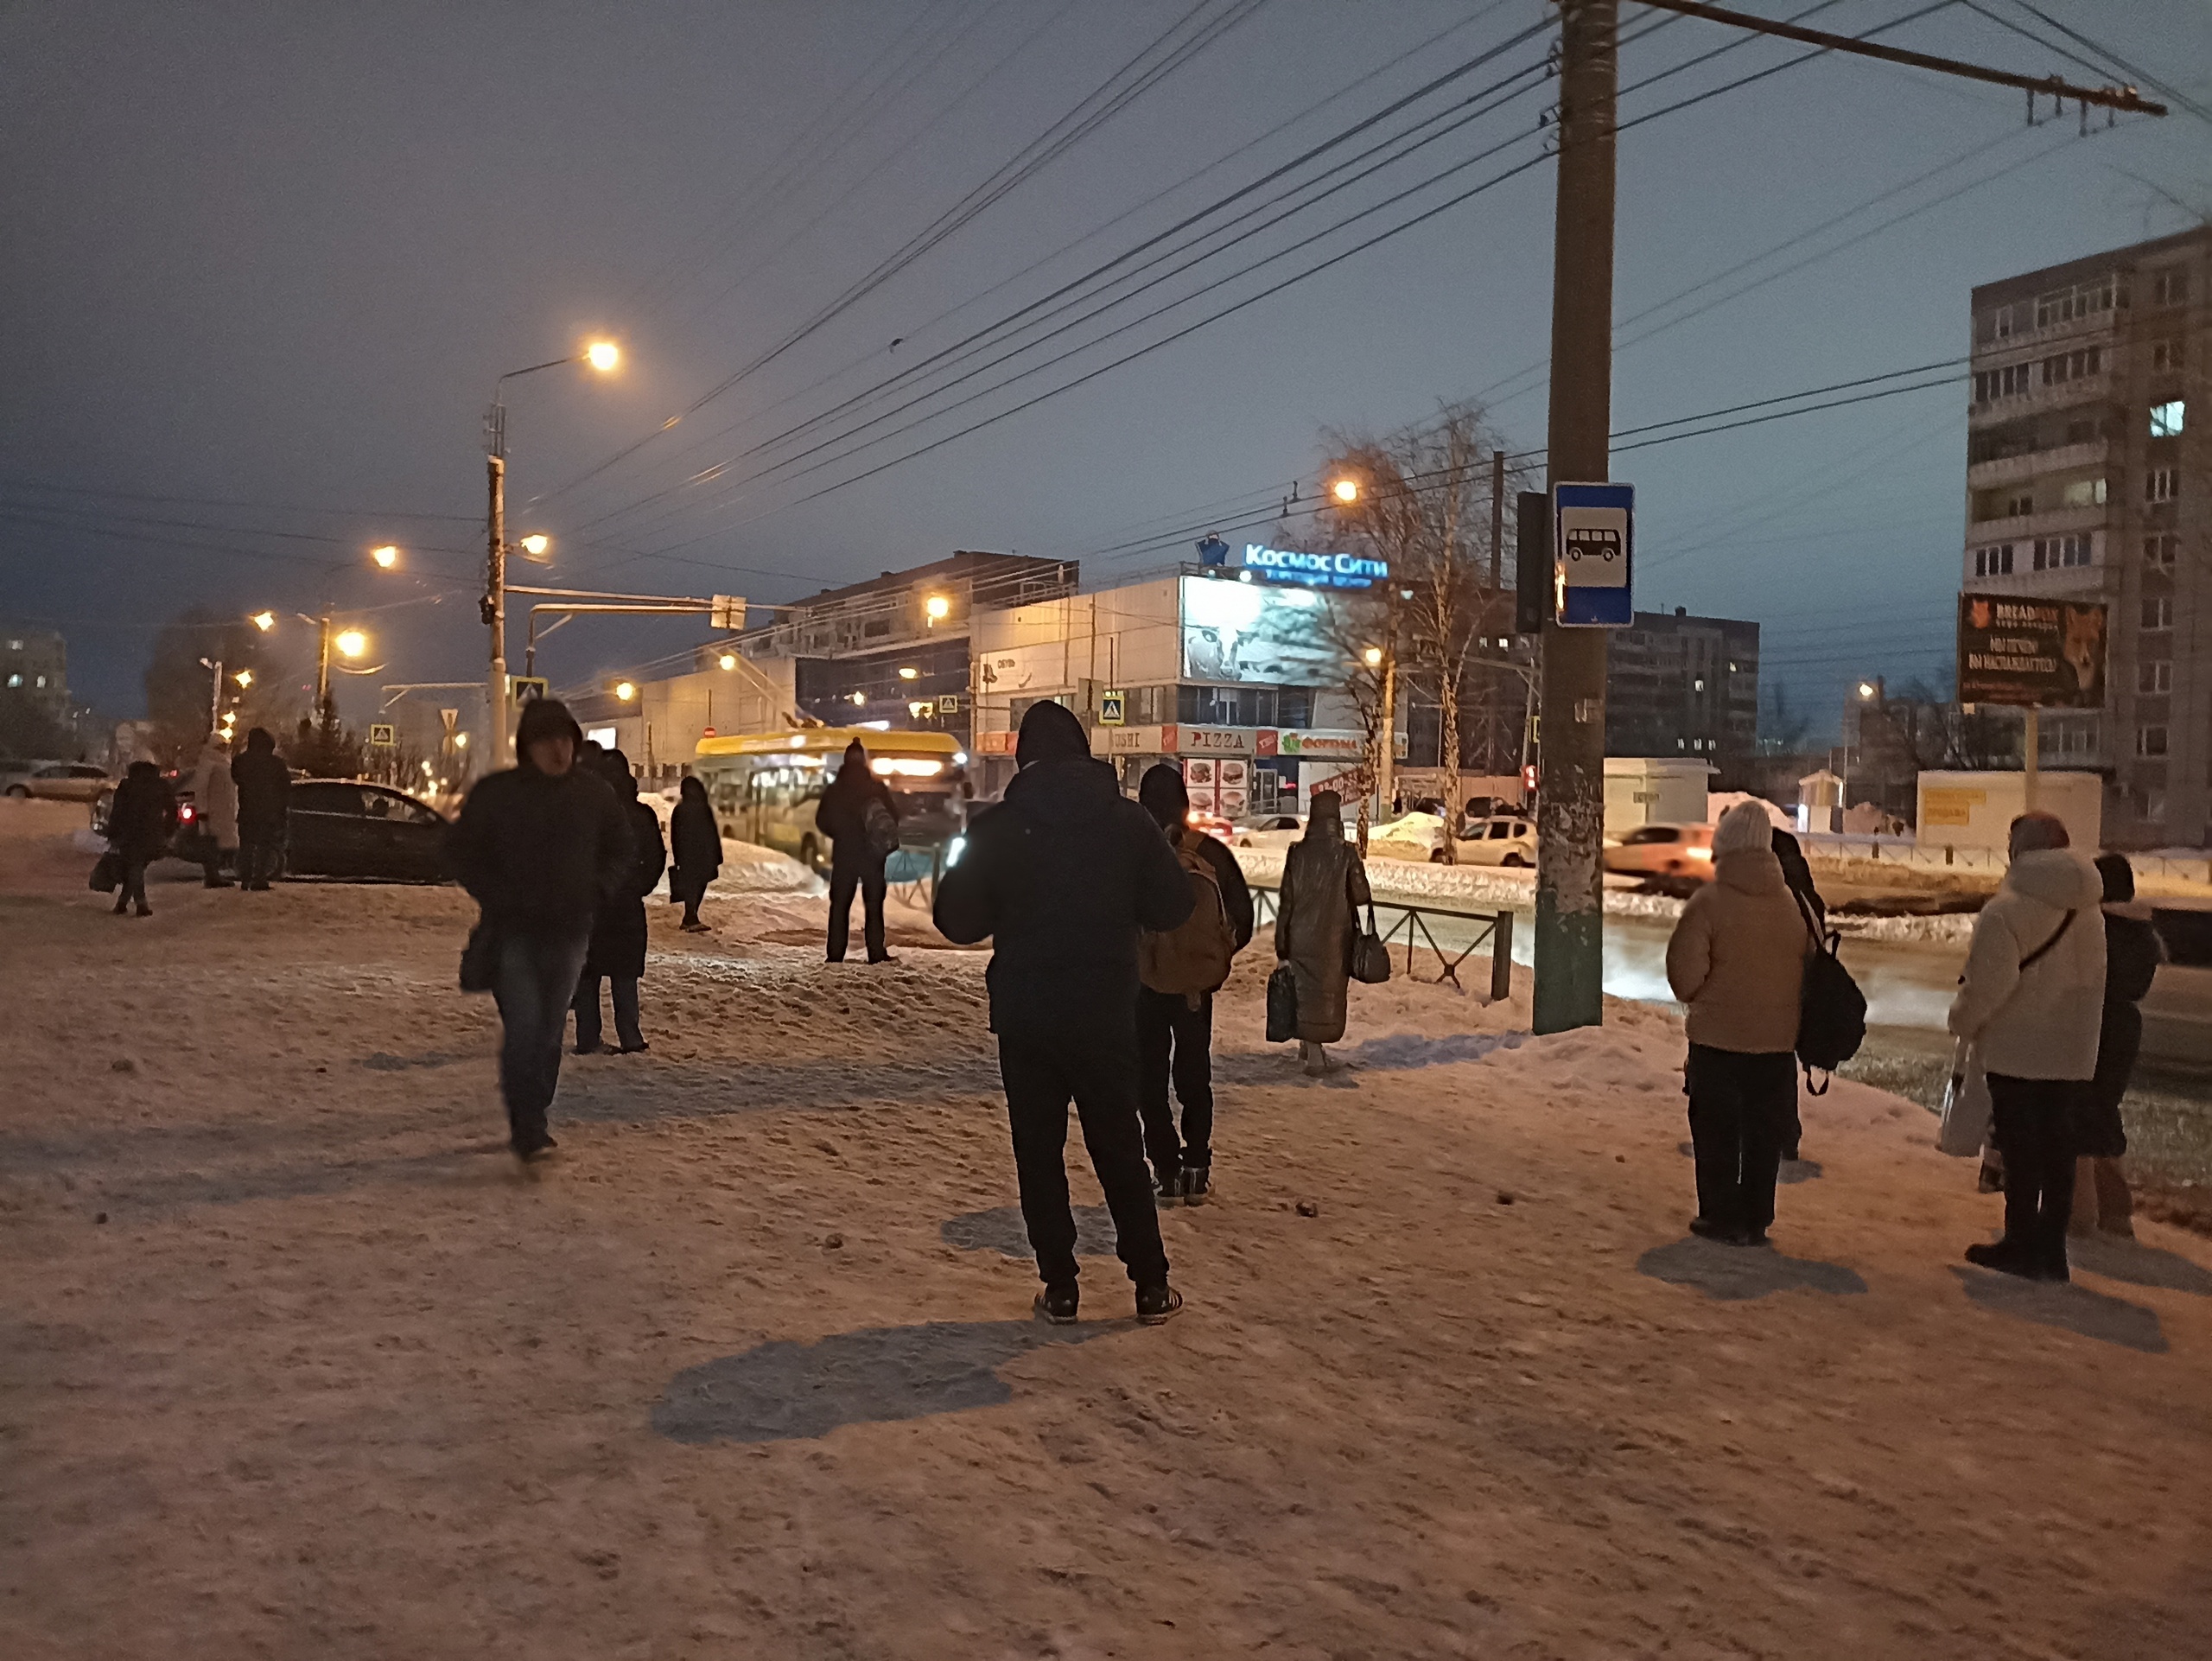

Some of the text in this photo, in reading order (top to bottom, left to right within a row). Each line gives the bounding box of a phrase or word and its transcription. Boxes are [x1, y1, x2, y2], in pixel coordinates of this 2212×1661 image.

[1245, 544, 1332, 571] Космос
[1335, 553, 1389, 577] Сити
[1112, 732, 1141, 748] USHI
[1191, 731, 1245, 748] PIZZA
